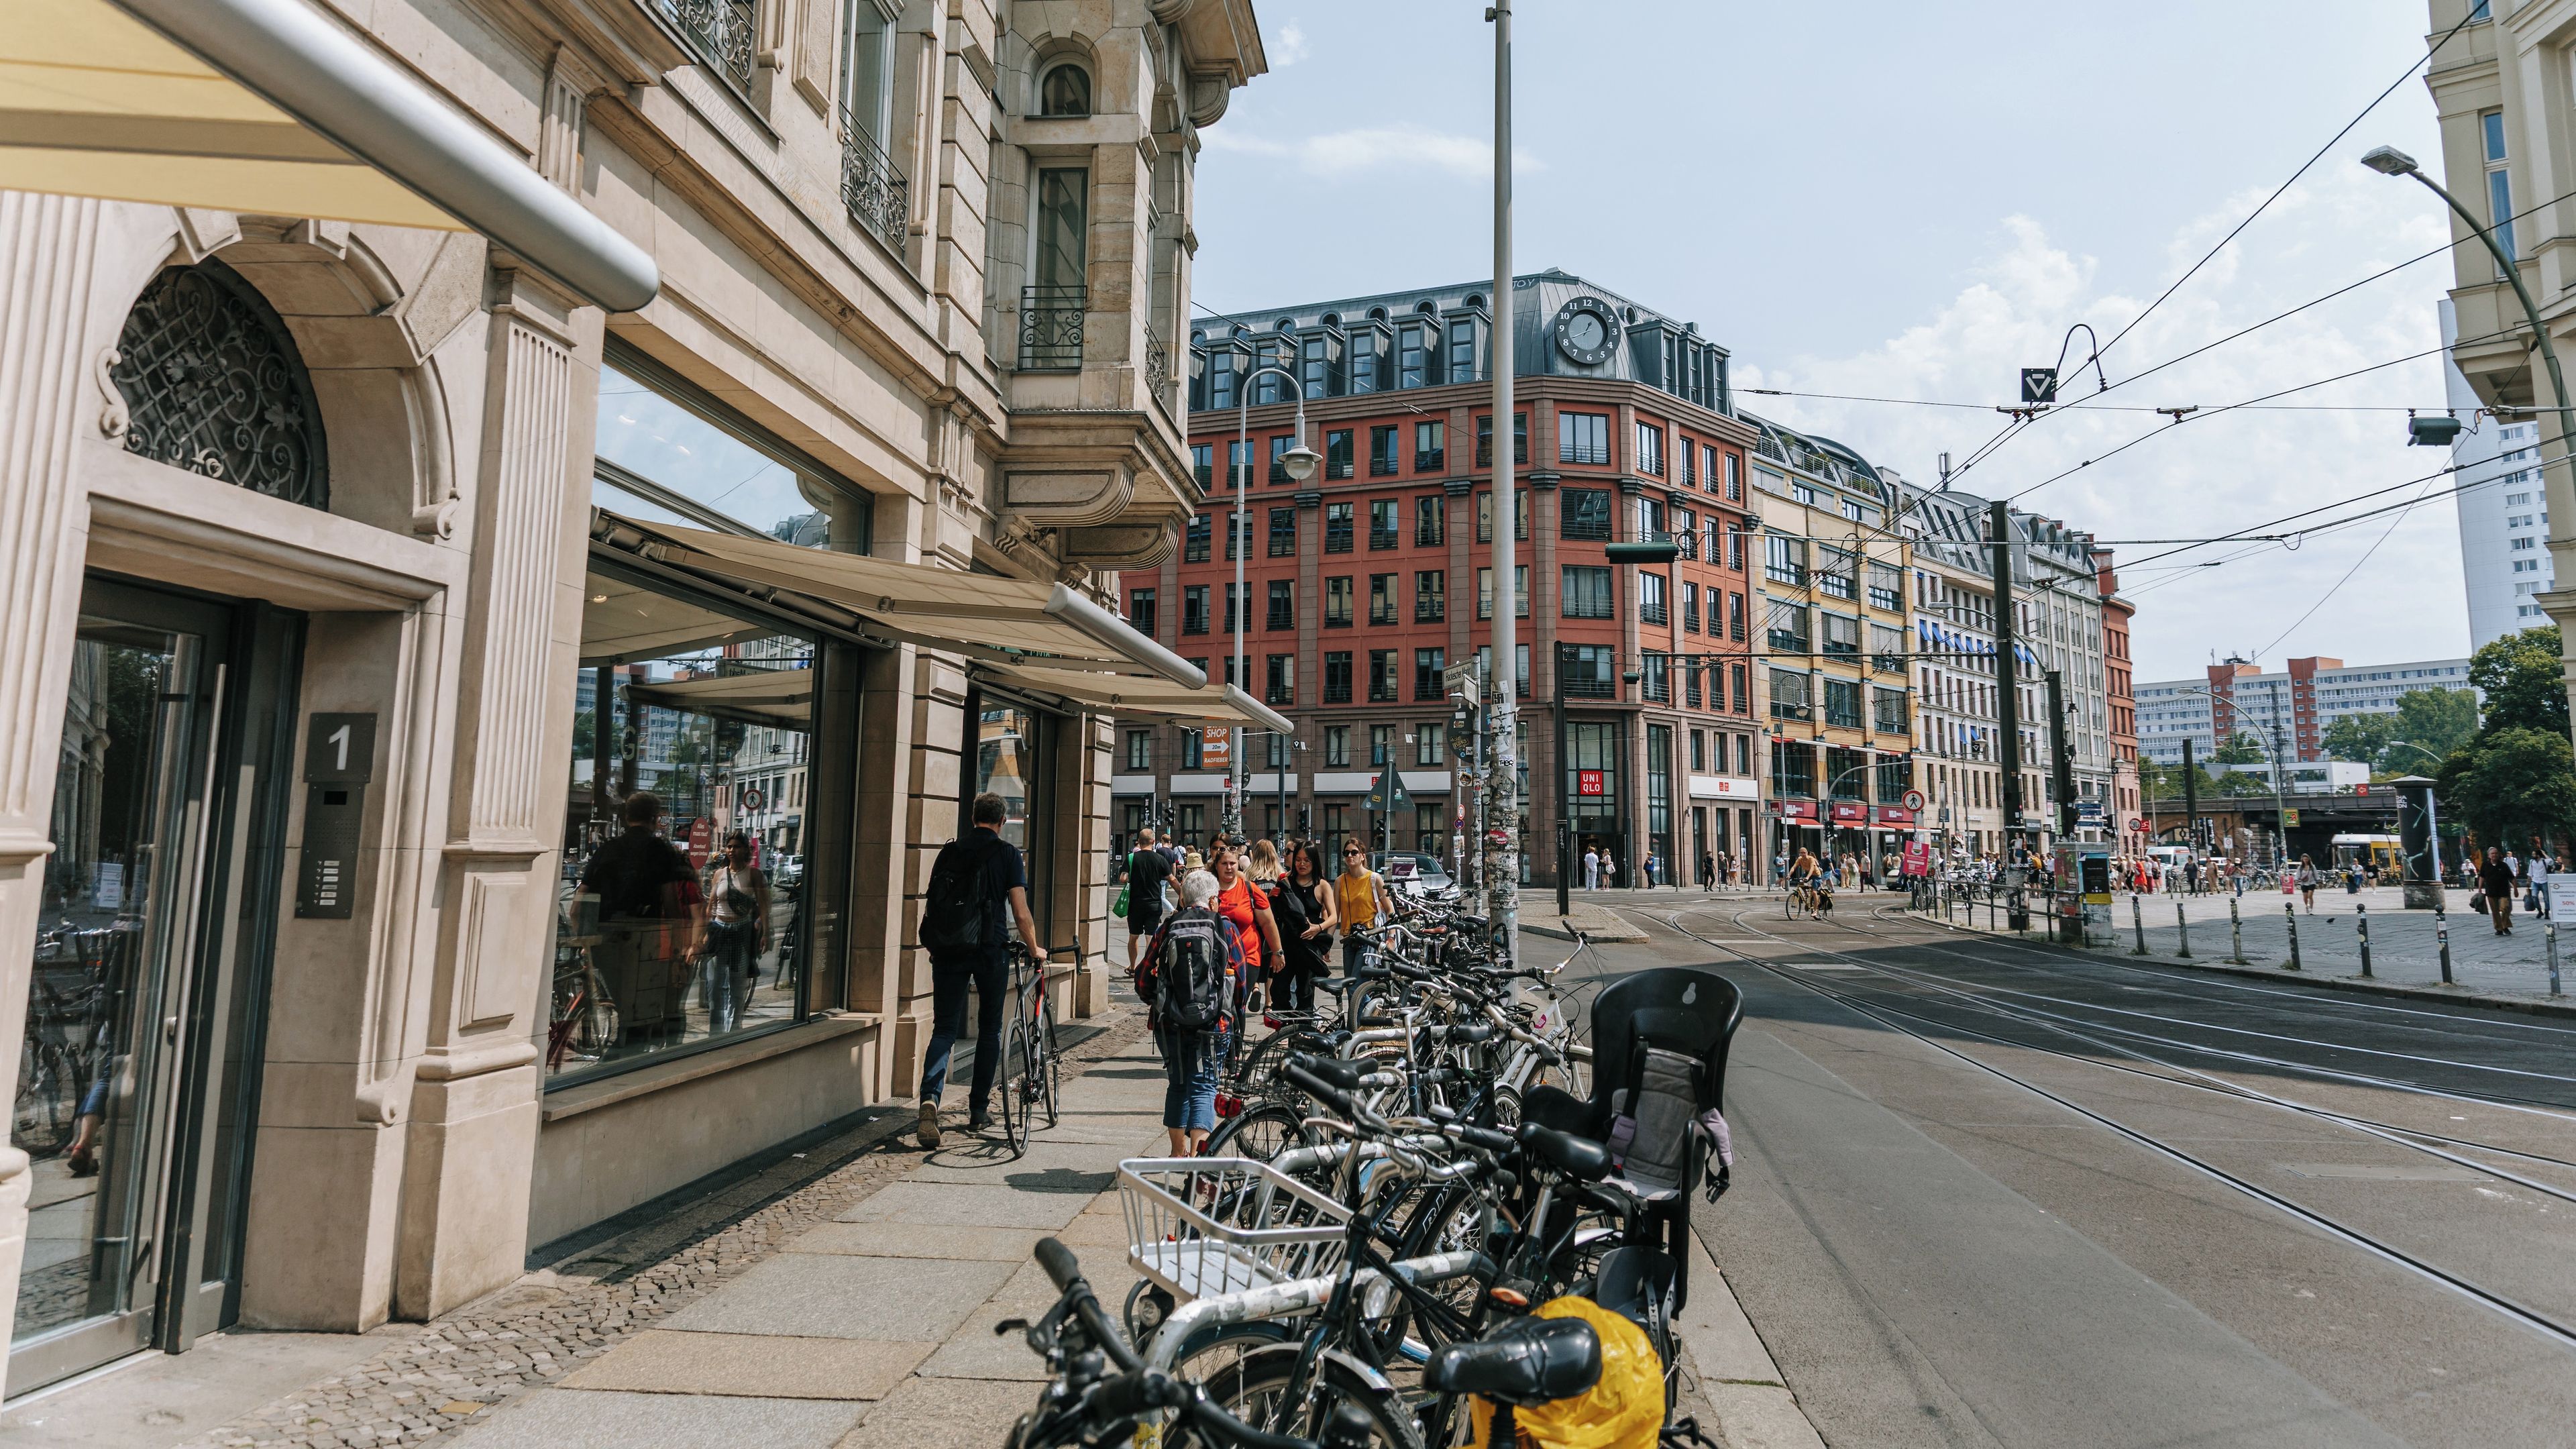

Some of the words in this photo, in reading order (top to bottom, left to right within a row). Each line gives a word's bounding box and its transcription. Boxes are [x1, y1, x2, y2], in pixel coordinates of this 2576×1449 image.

[1206, 729, 1227, 738] SHOP
[328, 724, 351, 770] 1
[1582, 773, 1599, 783] UNI
[1582, 783, 1601, 794] QLO
